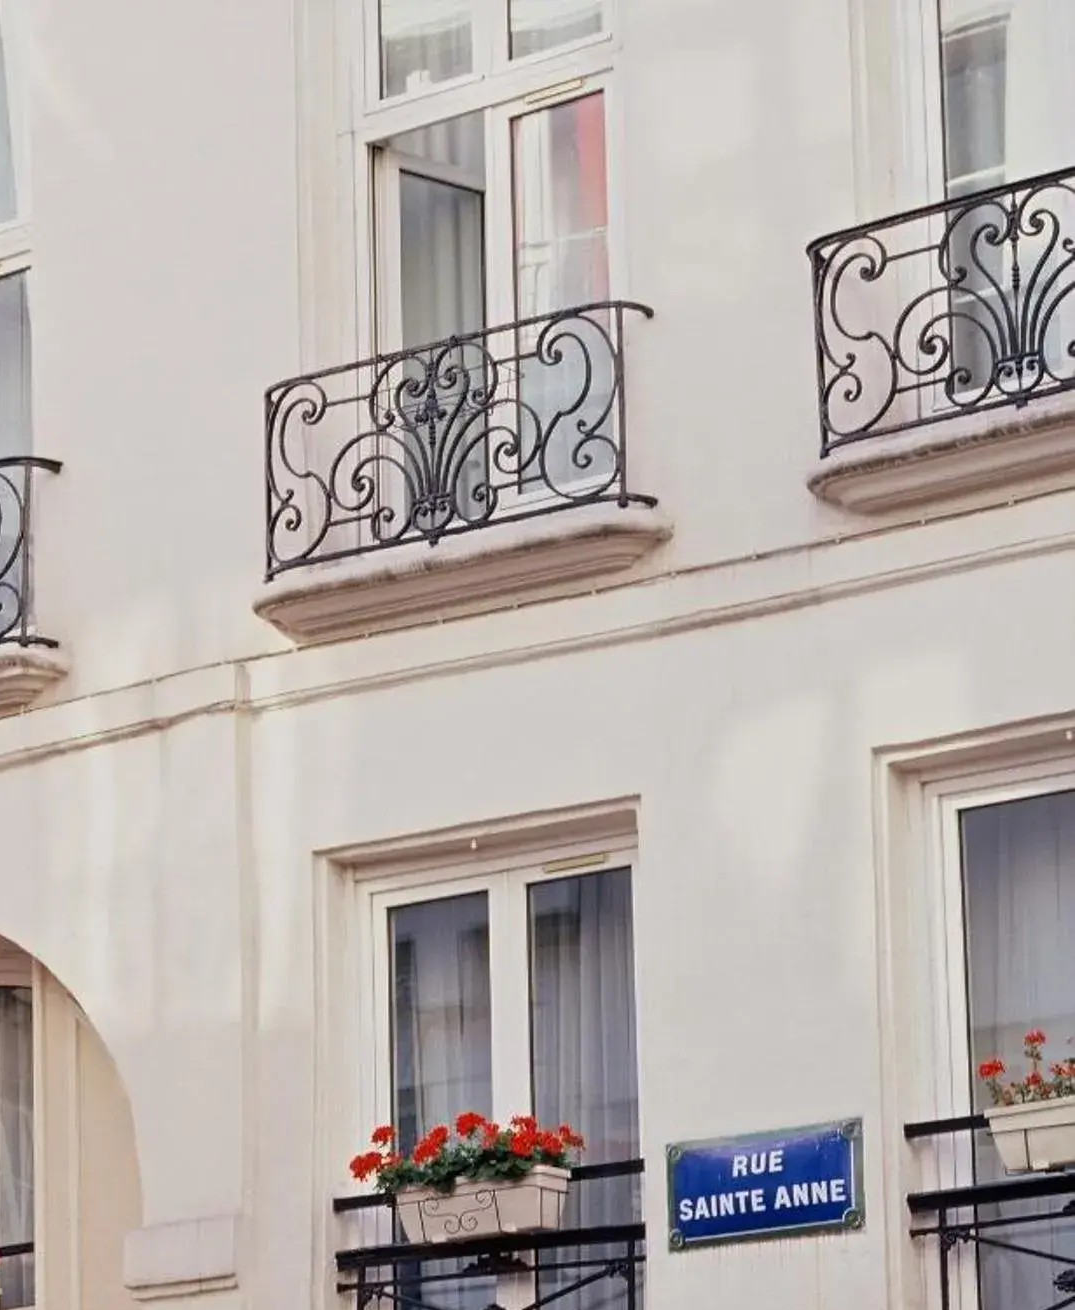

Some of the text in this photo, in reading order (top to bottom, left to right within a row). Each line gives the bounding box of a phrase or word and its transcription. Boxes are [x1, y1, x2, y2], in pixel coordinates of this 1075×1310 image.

[732, 1150, 784, 1178] RUE
[679, 1178, 847, 1222] SAINTE ANNE
